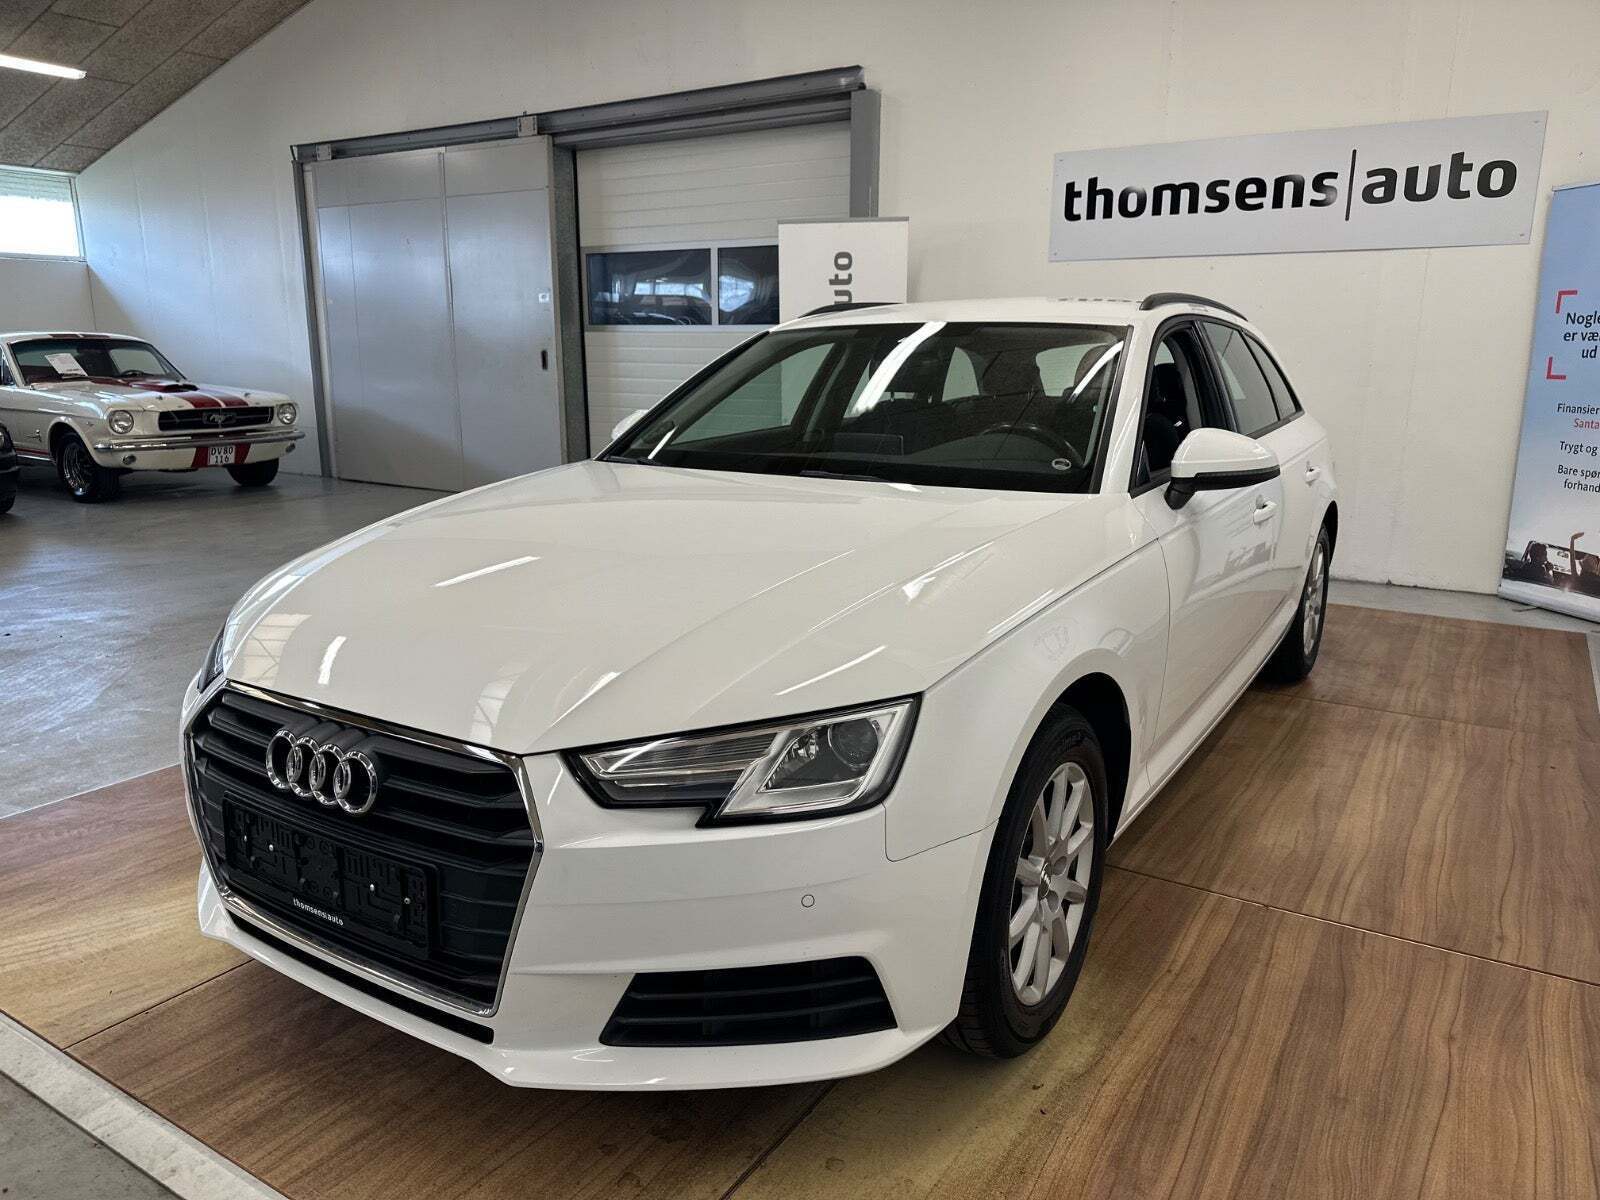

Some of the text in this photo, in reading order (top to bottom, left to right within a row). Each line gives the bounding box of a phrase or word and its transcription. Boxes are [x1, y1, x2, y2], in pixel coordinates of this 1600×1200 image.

[1563, 331, 1600, 342] er væ
[1581, 345, 1598, 359] ud
[1557, 402, 1600, 415] Finansier
[1574, 418, 1600, 430] Santa
[1560, 440, 1598, 457] Trygt og
[1557, 464, 1578, 476] Bare
[1564, 478, 1600, 493] forhand
